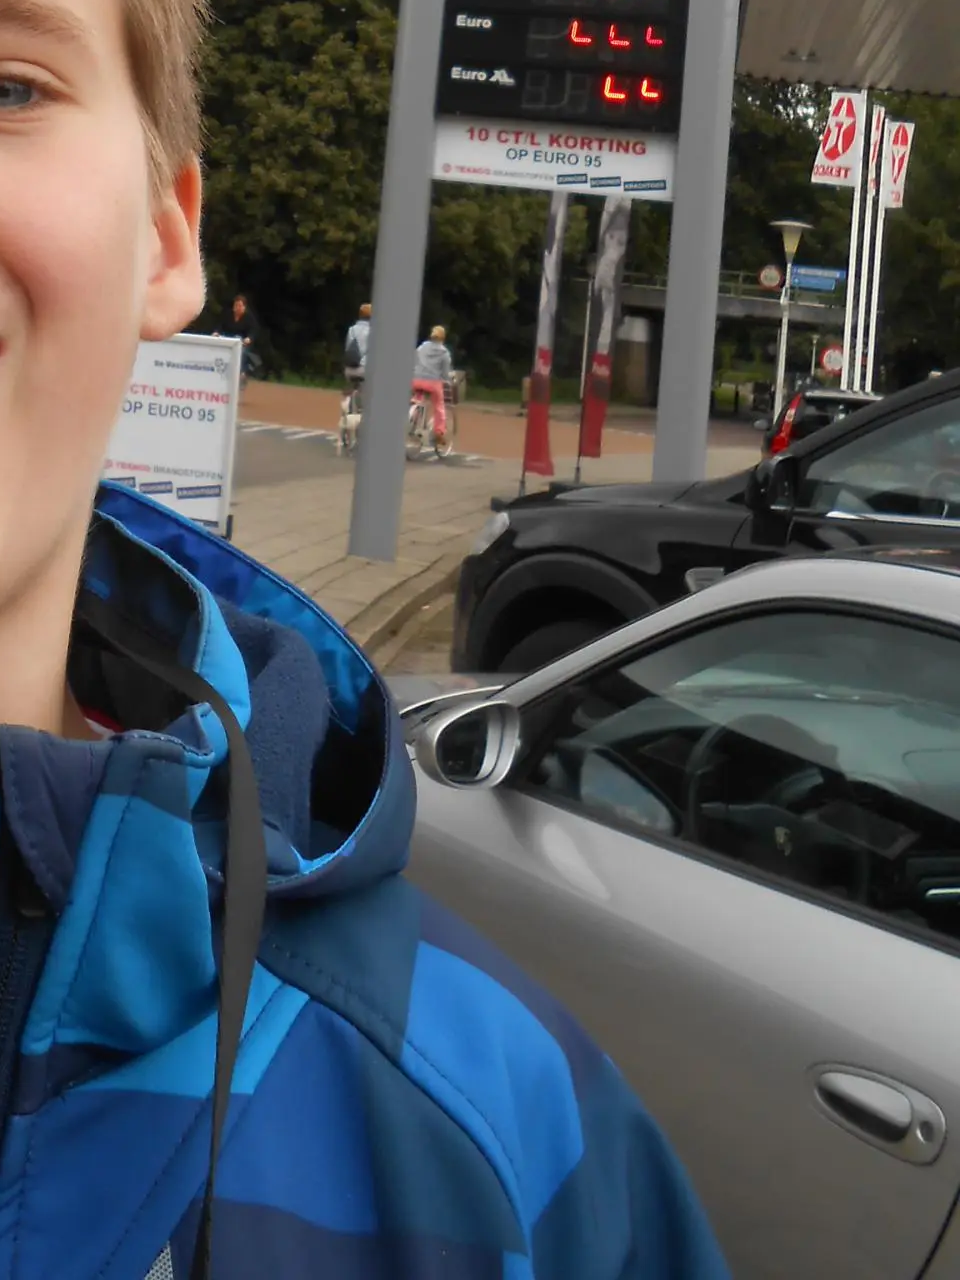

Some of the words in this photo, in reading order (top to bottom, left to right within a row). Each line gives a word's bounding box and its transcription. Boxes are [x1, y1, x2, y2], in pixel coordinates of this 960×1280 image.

[456, 14, 492, 29] Euro
[451, 67, 487, 81] Euro
[467, 126, 489, 142] 10
[548, 133, 647, 156] KORTING
[506, 148, 528, 161] OP
[533, 150, 579, 166] EURO
[584, 154, 602, 168] 95
[165, 387, 231, 404] KORTING
[122, 400, 143, 413] OP
[148, 402, 193, 420] EURO
[198, 408, 216, 422] 95
